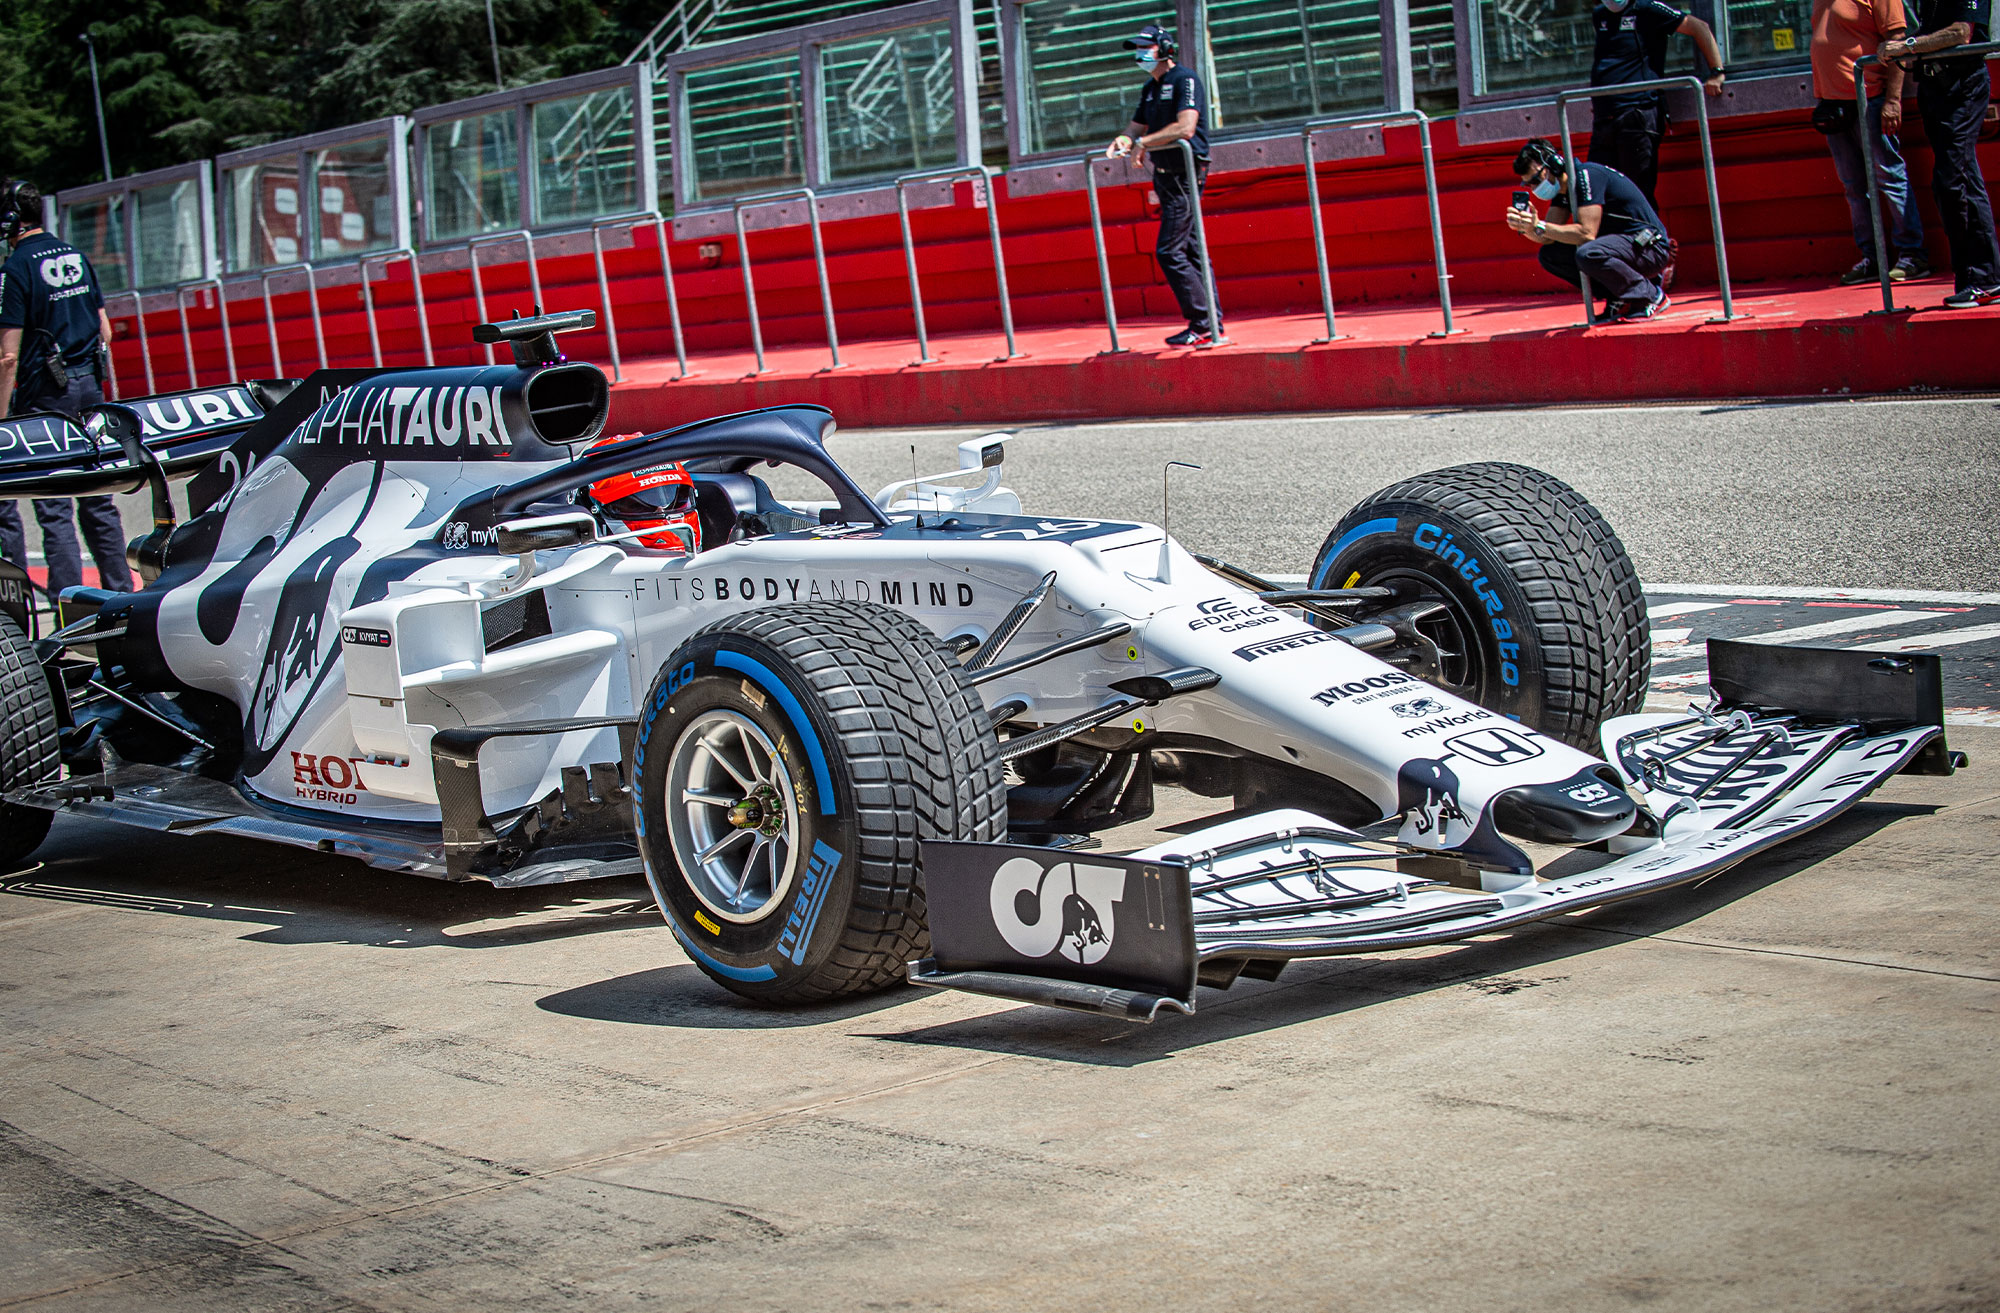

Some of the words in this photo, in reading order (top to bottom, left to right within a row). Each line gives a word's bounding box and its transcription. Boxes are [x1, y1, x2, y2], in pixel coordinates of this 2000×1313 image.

[286, 386, 513, 446] ALPHATAURI
[639, 474, 682, 487] HONDA
[1188, 604, 1279, 631] EDIFICE
[1413, 522, 1520, 687] Cinturato
[359, 631, 378, 643] KVYAT
[1218, 615, 1280, 633] CASIO
[1401, 709, 1494, 739] myWorld
[631, 660, 695, 838] Cinturato
[296, 786, 358, 805] HYBRID
[776, 837, 843, 966] PIRELLI
